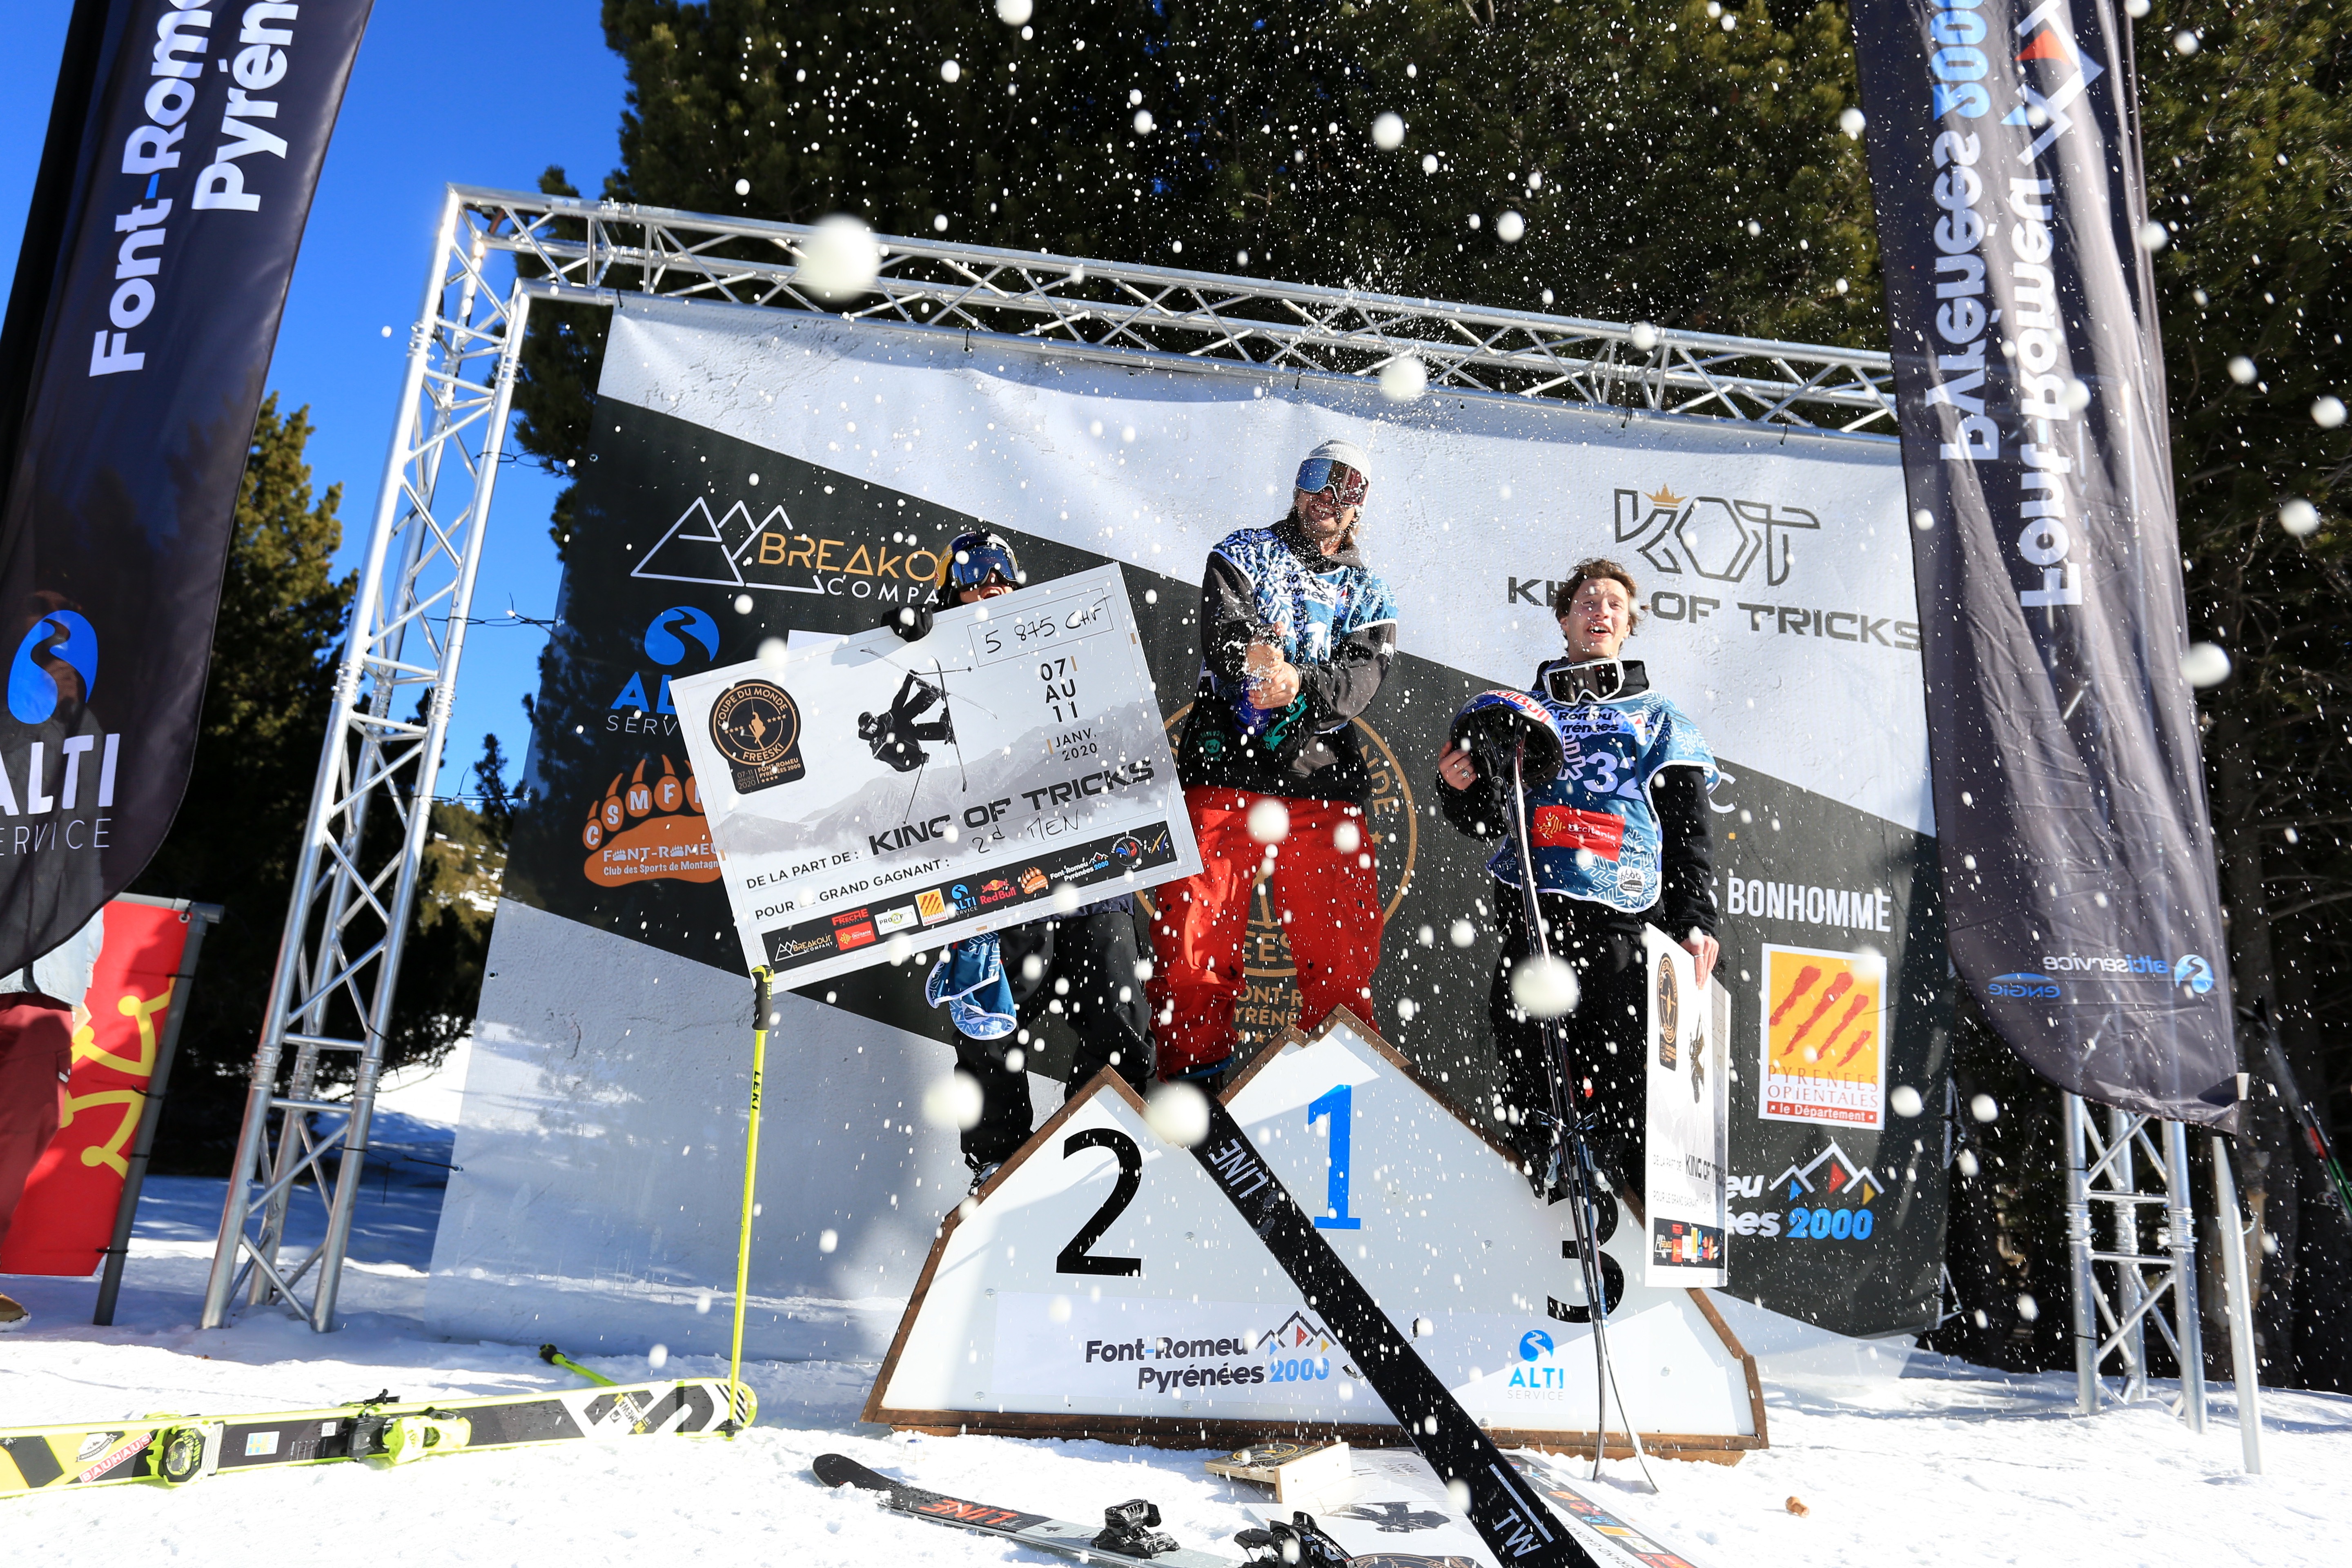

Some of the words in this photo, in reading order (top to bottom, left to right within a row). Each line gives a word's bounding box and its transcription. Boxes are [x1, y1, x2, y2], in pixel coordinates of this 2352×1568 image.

[192, 0, 299, 212] Pyrén
[89, 0, 213, 377] Font-Rom
[1651, 591, 1720, 624] OF
[1737, 602, 1921, 650] TRICKS
[985, 629, 1002, 653] 5
[1040, 658, 1067, 682] 07
[737, 688, 751, 697] DU
[754, 688, 788, 711] MONDE
[1045, 679, 1076, 704] AU
[1053, 701, 1078, 723] 11
[1512, 694, 1552, 724] Bull
[1055, 727, 1097, 748] JANV.
[743, 742, 784, 762] FREESKI
[1062, 743, 1098, 762] 2020
[757, 757, 799, 773] FONTROMEU
[759, 767, 787, 778] PYREEES
[787, 763, 801, 772] 2000
[738, 780, 756, 790] 2020
[746, 875, 766, 889] DE
[769, 869, 788, 882] LA
[792, 858, 827, 877] PART
[869, 815, 955, 856] KING
[963, 797, 1012, 829] OF
[1021, 760, 1154, 811] TRICKS
[1568, 824, 1617, 841] Occitanie
[603, 865, 621, 875] Club
[624, 864, 637, 874] des
[639, 863, 667, 875] Sports
[670, 862, 679, 871] de
[1050, 861, 1089, 880] Font-Romeu
[1064, 866, 1094, 882] Pyrénées
[1094, 860, 1109, 871] 2000
[755, 900, 795, 921] POUR
[819, 880, 869, 902] GRAND
[873, 859, 941, 886] GAGNANT
[980, 895, 998, 904] Red
[1000, 886, 1017, 899] Bull
[952, 896, 977, 911] ALTI
[1728, 877, 1891, 933] BONHOMME
[832, 908, 869, 926] FRECHE
[793, 934, 831, 952] BREAKOUT
[806, 941, 833, 953] COMPANY
[751, 1070, 761, 1110] LEKI
[1768, 1085, 1878, 1108] ORIENTALES
[1780, 1102, 1791, 1114] le
[1795, 1105, 1865, 1122] Département
[1307, 1084, 1361, 1229] 1
[1686, 1153, 1702, 1179] KING
[1704, 1160, 1711, 1181] OF
[1056, 1128, 1143, 1277] 2
[1785, 1207, 1873, 1241] 2000
[1547, 1179, 1625, 1323] 3
[1085, 1336, 1249, 1363] Font-Romeu
[1138, 1362, 1265, 1394] Pyrénées
[1269, 1358, 1330, 1383] 2000
[1508, 1367, 1564, 1389] ALTI
[1507, 1389, 1564, 1402] SERVICE
[81, 1434, 152, 1482] BAUHAUS
[918, 1499, 1019, 1524] LINE
